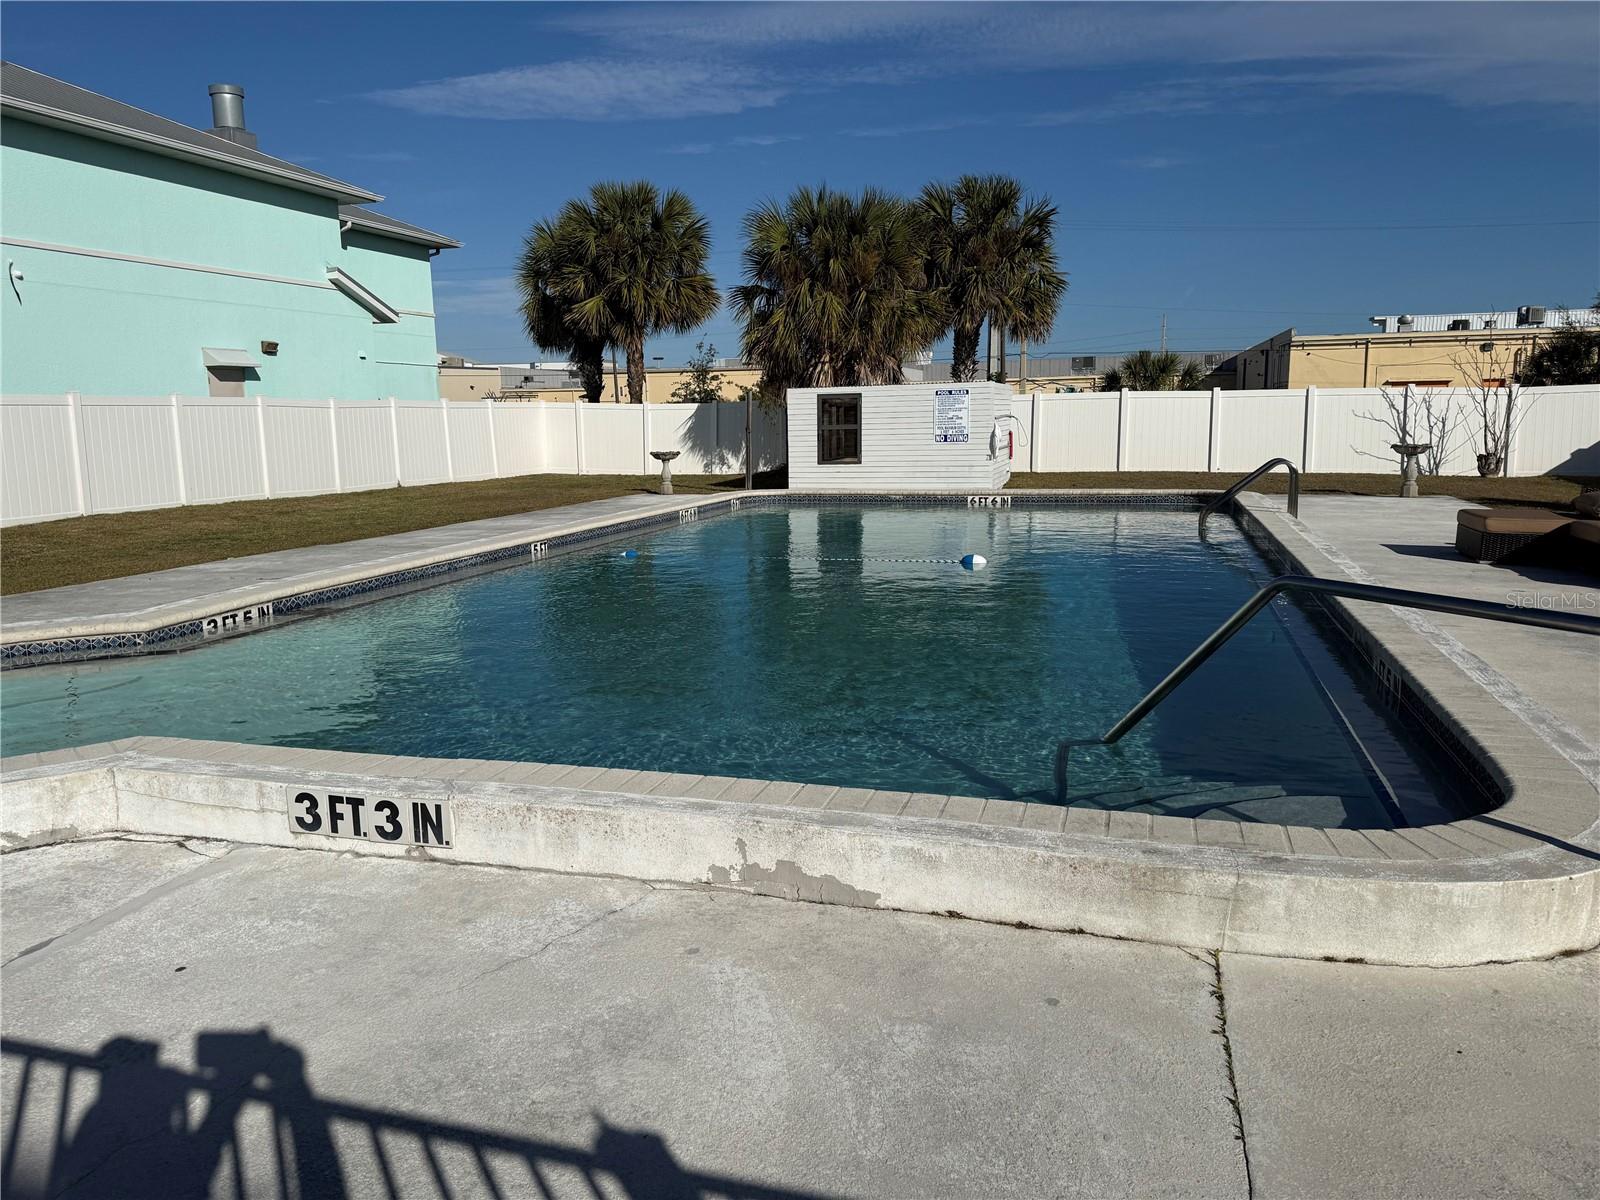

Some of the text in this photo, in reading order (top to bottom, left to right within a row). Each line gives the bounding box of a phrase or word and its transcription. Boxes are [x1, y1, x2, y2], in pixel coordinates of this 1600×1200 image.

[946, 434, 968, 442] DIVING
[970, 496, 977, 506] 6
[979, 496, 989, 506] FT
[991, 496, 998, 507] 6
[206, 618, 218, 634] 3
[222, 613, 238, 630] FT
[257, 604, 269, 618] IN
[295, 792, 322, 832] 3
[374, 800, 403, 841] 3
